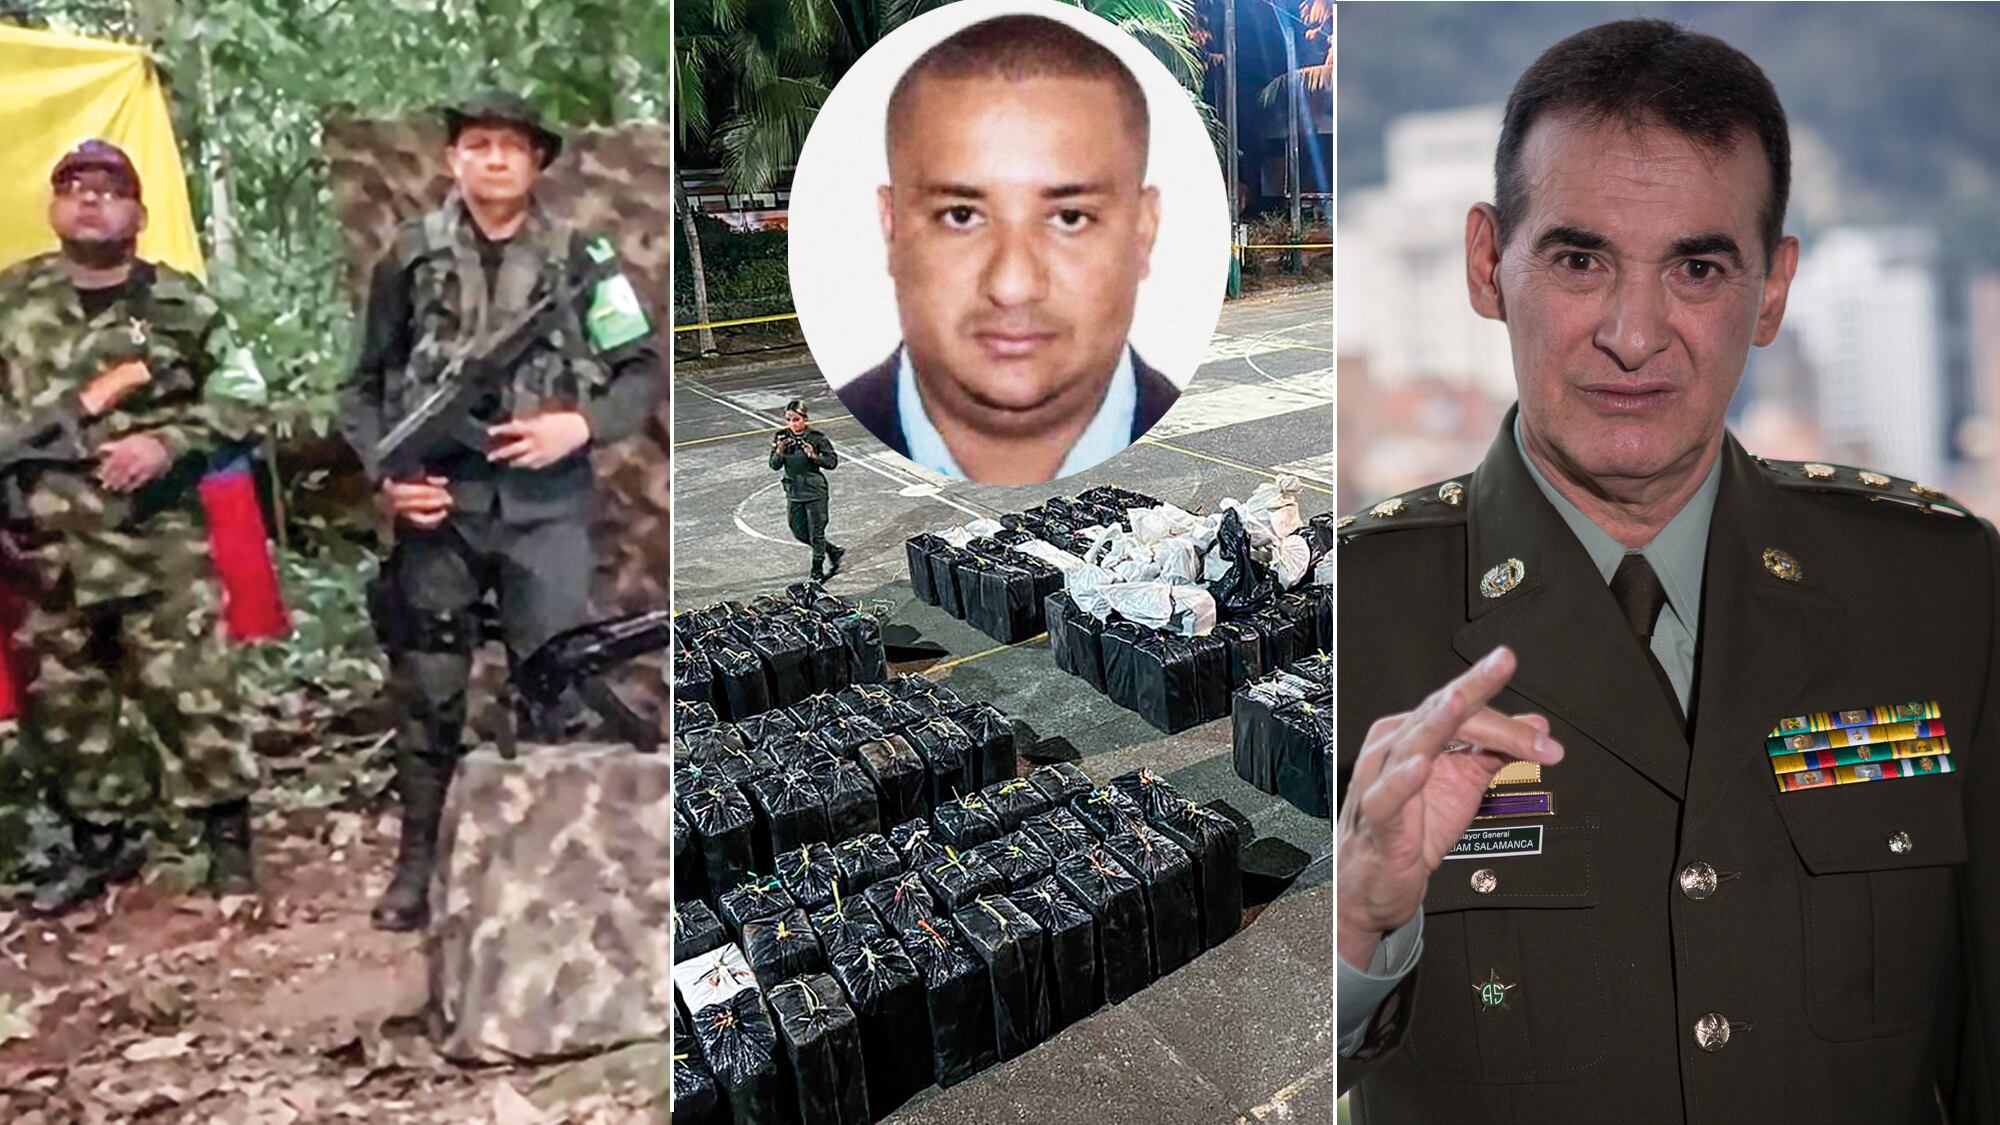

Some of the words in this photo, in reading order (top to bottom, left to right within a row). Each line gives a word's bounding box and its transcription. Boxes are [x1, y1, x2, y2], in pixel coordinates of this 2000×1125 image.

[1482, 831, 1510, 839] General
[1473, 839, 1534, 851] SALAMANCA
[1482, 984, 1503, 1005] AS
